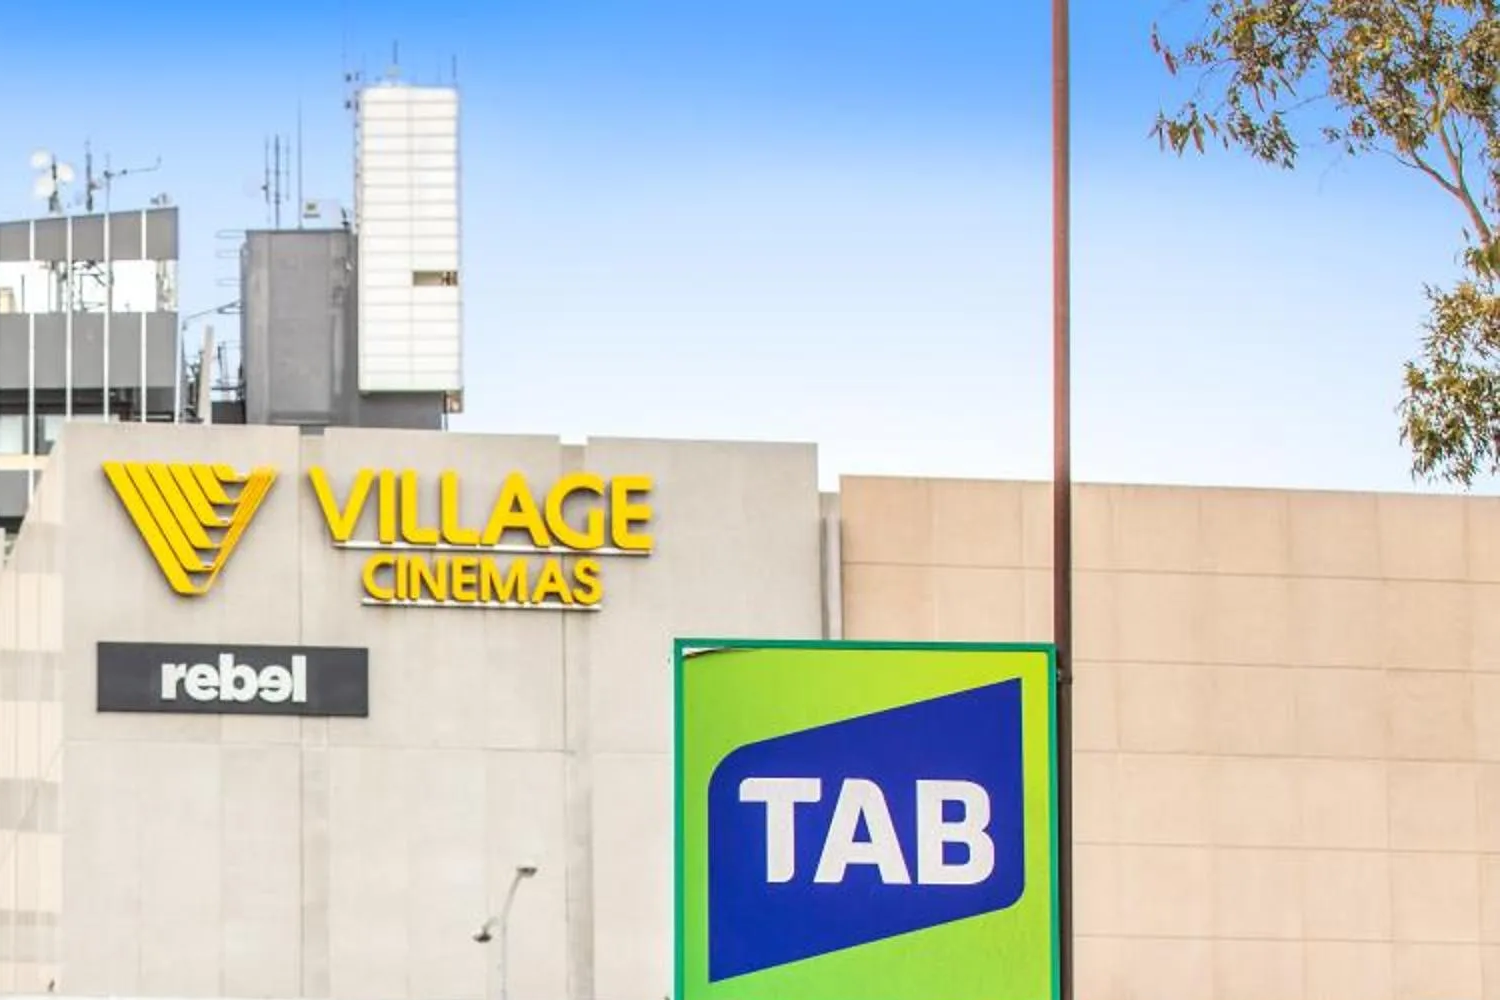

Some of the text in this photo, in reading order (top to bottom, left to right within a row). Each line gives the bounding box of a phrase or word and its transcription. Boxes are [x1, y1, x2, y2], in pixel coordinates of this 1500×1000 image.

[307, 465, 654, 551] VILLAGE
[361, 553, 603, 605] CINEMAS
[161, 653, 307, 703] rebel
[739, 777, 995, 885] TAB
